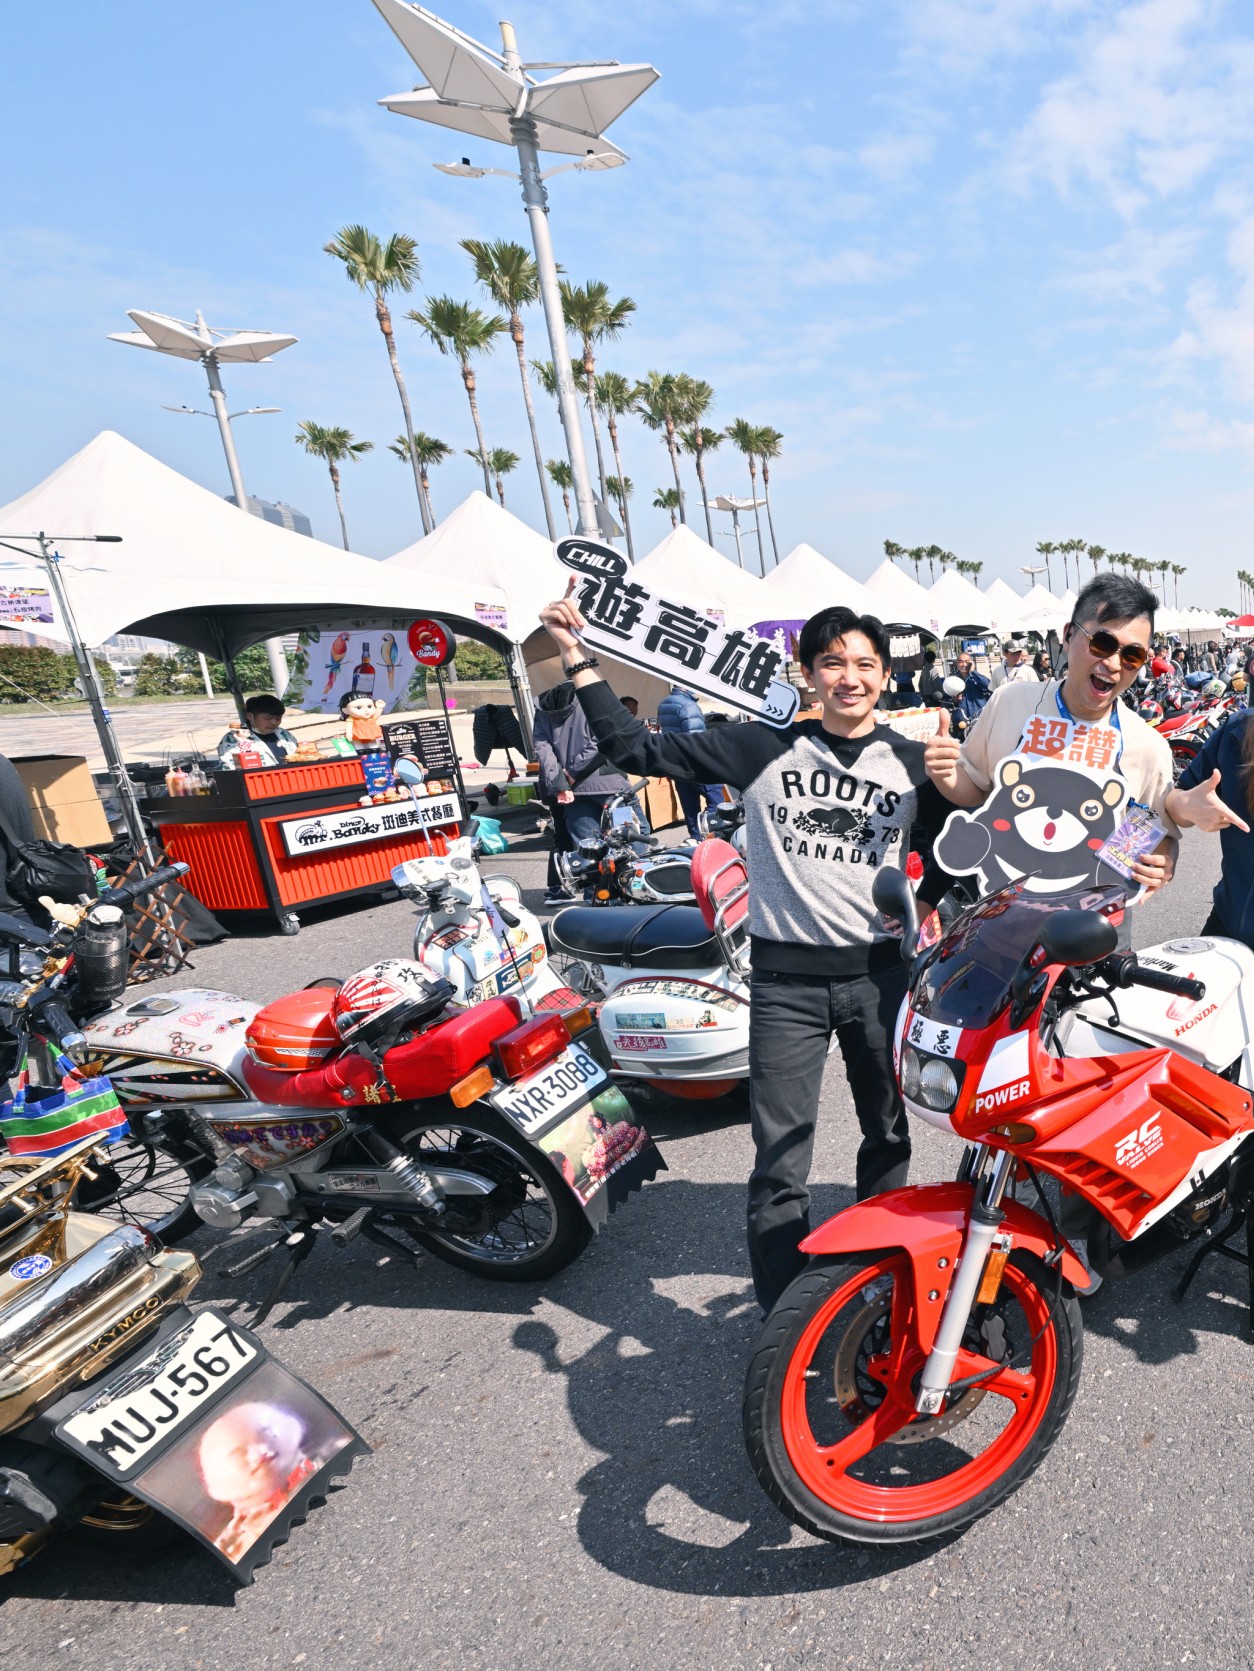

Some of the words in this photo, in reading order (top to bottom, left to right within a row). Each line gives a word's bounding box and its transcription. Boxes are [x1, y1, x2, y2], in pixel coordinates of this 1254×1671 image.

[567, 547, 616, 573] CHILL
[578, 576, 783, 701] 遊高雄
[389, 733, 417, 742] BURGER
[1020, 717, 1117, 770] 超讚
[781, 769, 901, 818] ROOTS
[768, 803, 788, 825] 19
[881, 826, 900, 844] 73
[783, 836, 878, 867] CANADA
[1174, 1003, 1219, 1037] HONDA
[975, 1080, 1031, 1114] POWER
[1114, 1110, 1162, 1160] RC
[1116, 1128, 1163, 1166] VALVE
[1126, 1151, 1144, 1167] LIQUID
[1194, 1188, 1227, 1211] HONDA
[90, 1296, 161, 1352] KYMCO
